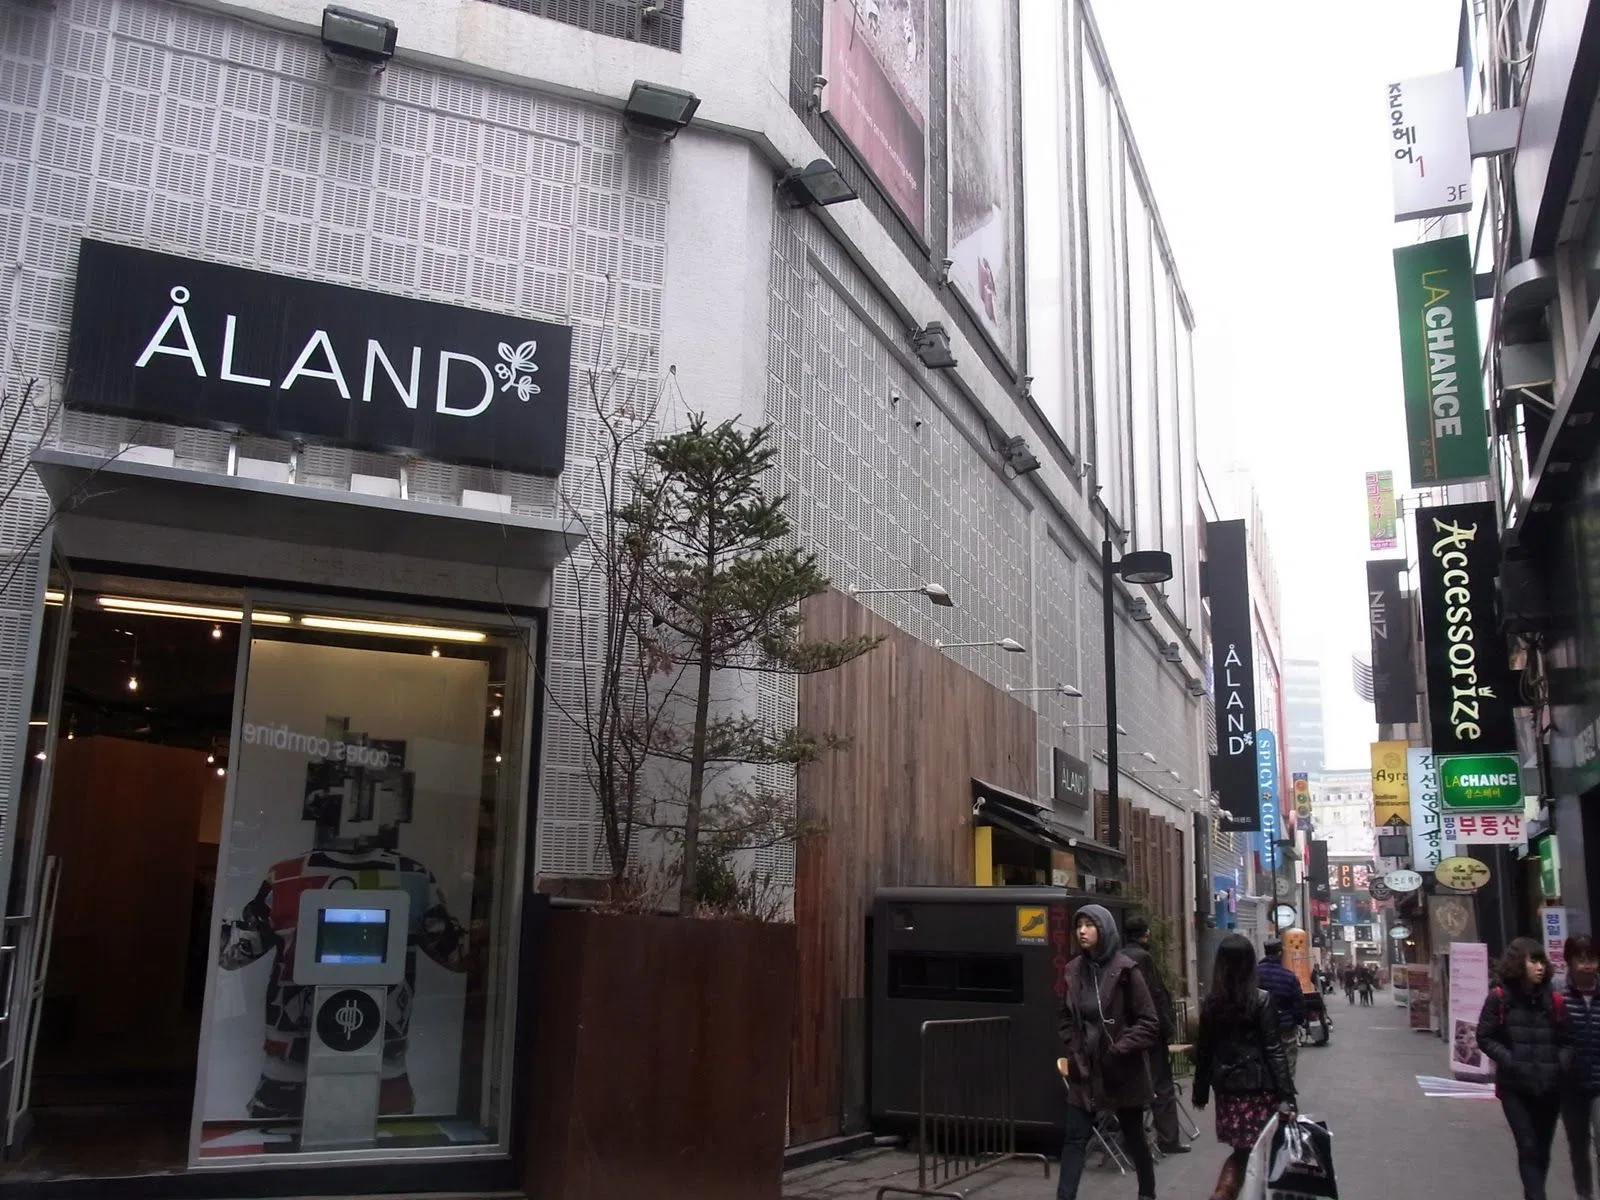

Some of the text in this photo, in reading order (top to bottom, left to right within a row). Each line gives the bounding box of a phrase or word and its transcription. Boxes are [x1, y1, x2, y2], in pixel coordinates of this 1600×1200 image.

[1388, 83, 1416, 164] 준오헤어
[1446, 184, 1467, 202] 3F
[135, 285, 496, 418] ÅLAND
[1432, 517, 1492, 740] Accessorize
[1224, 643, 1245, 755] ÅLAND
[1260, 740, 1273, 789] SPICY
[1460, 815, 1521, 837] 부동산
